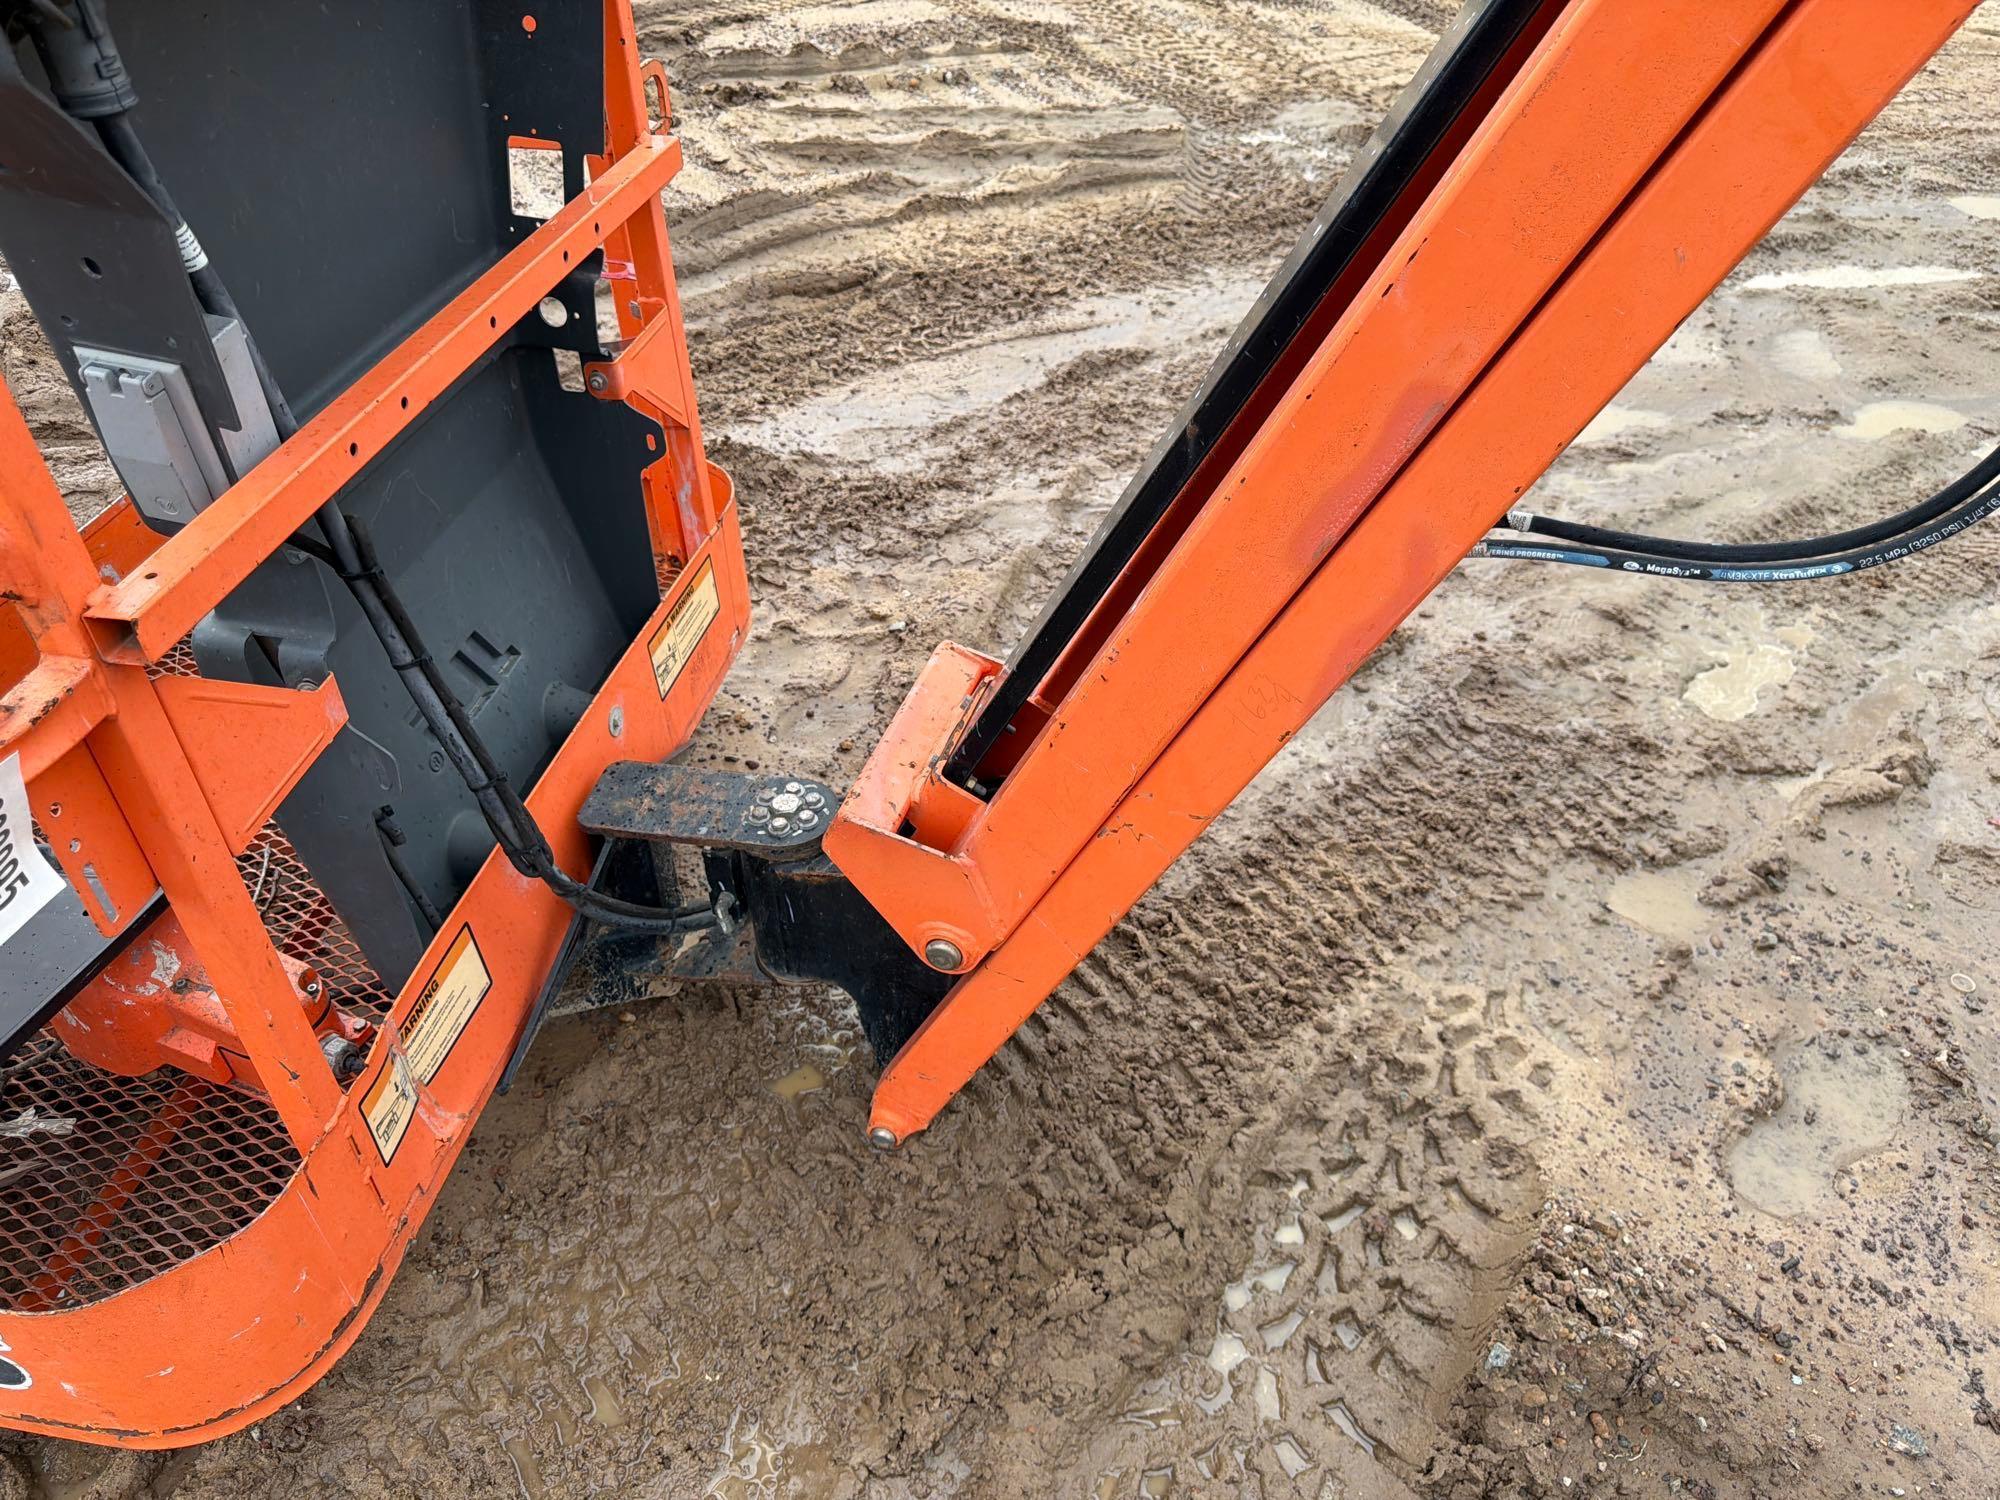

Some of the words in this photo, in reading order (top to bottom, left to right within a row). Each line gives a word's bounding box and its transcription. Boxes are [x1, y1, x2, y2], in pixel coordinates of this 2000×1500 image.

[1859, 554, 1883, 568] 22.5
[1884, 546, 1908, 561] MPa
[1908, 532, 1942, 552] (3250
[670, 584, 695, 623] WARNING
